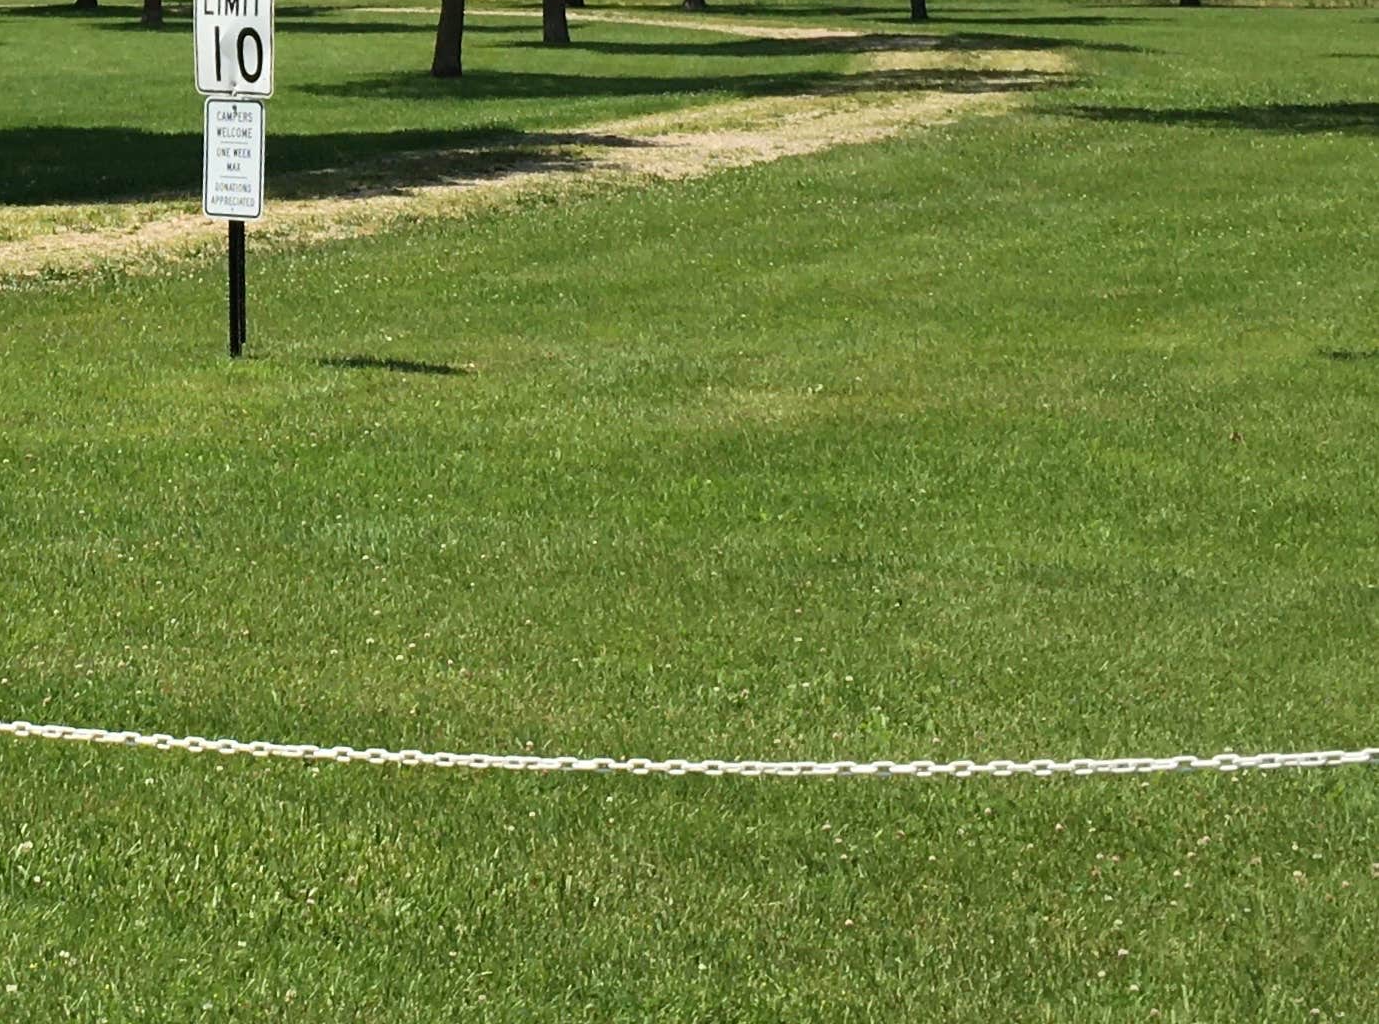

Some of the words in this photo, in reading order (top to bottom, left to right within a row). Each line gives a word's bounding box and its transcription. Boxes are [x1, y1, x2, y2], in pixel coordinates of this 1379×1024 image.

[214, 25, 263, 83] 10
[216, 111, 253, 123] CAMPERS
[216, 127, 253, 139] WELCOME
[216, 147, 231, 158] ONE
[233, 148, 251, 159] WEEK
[226, 162, 241, 171] MAX
[215, 182, 252, 193] DONATIONS
[211, 195, 255, 207] APPRECIATED
